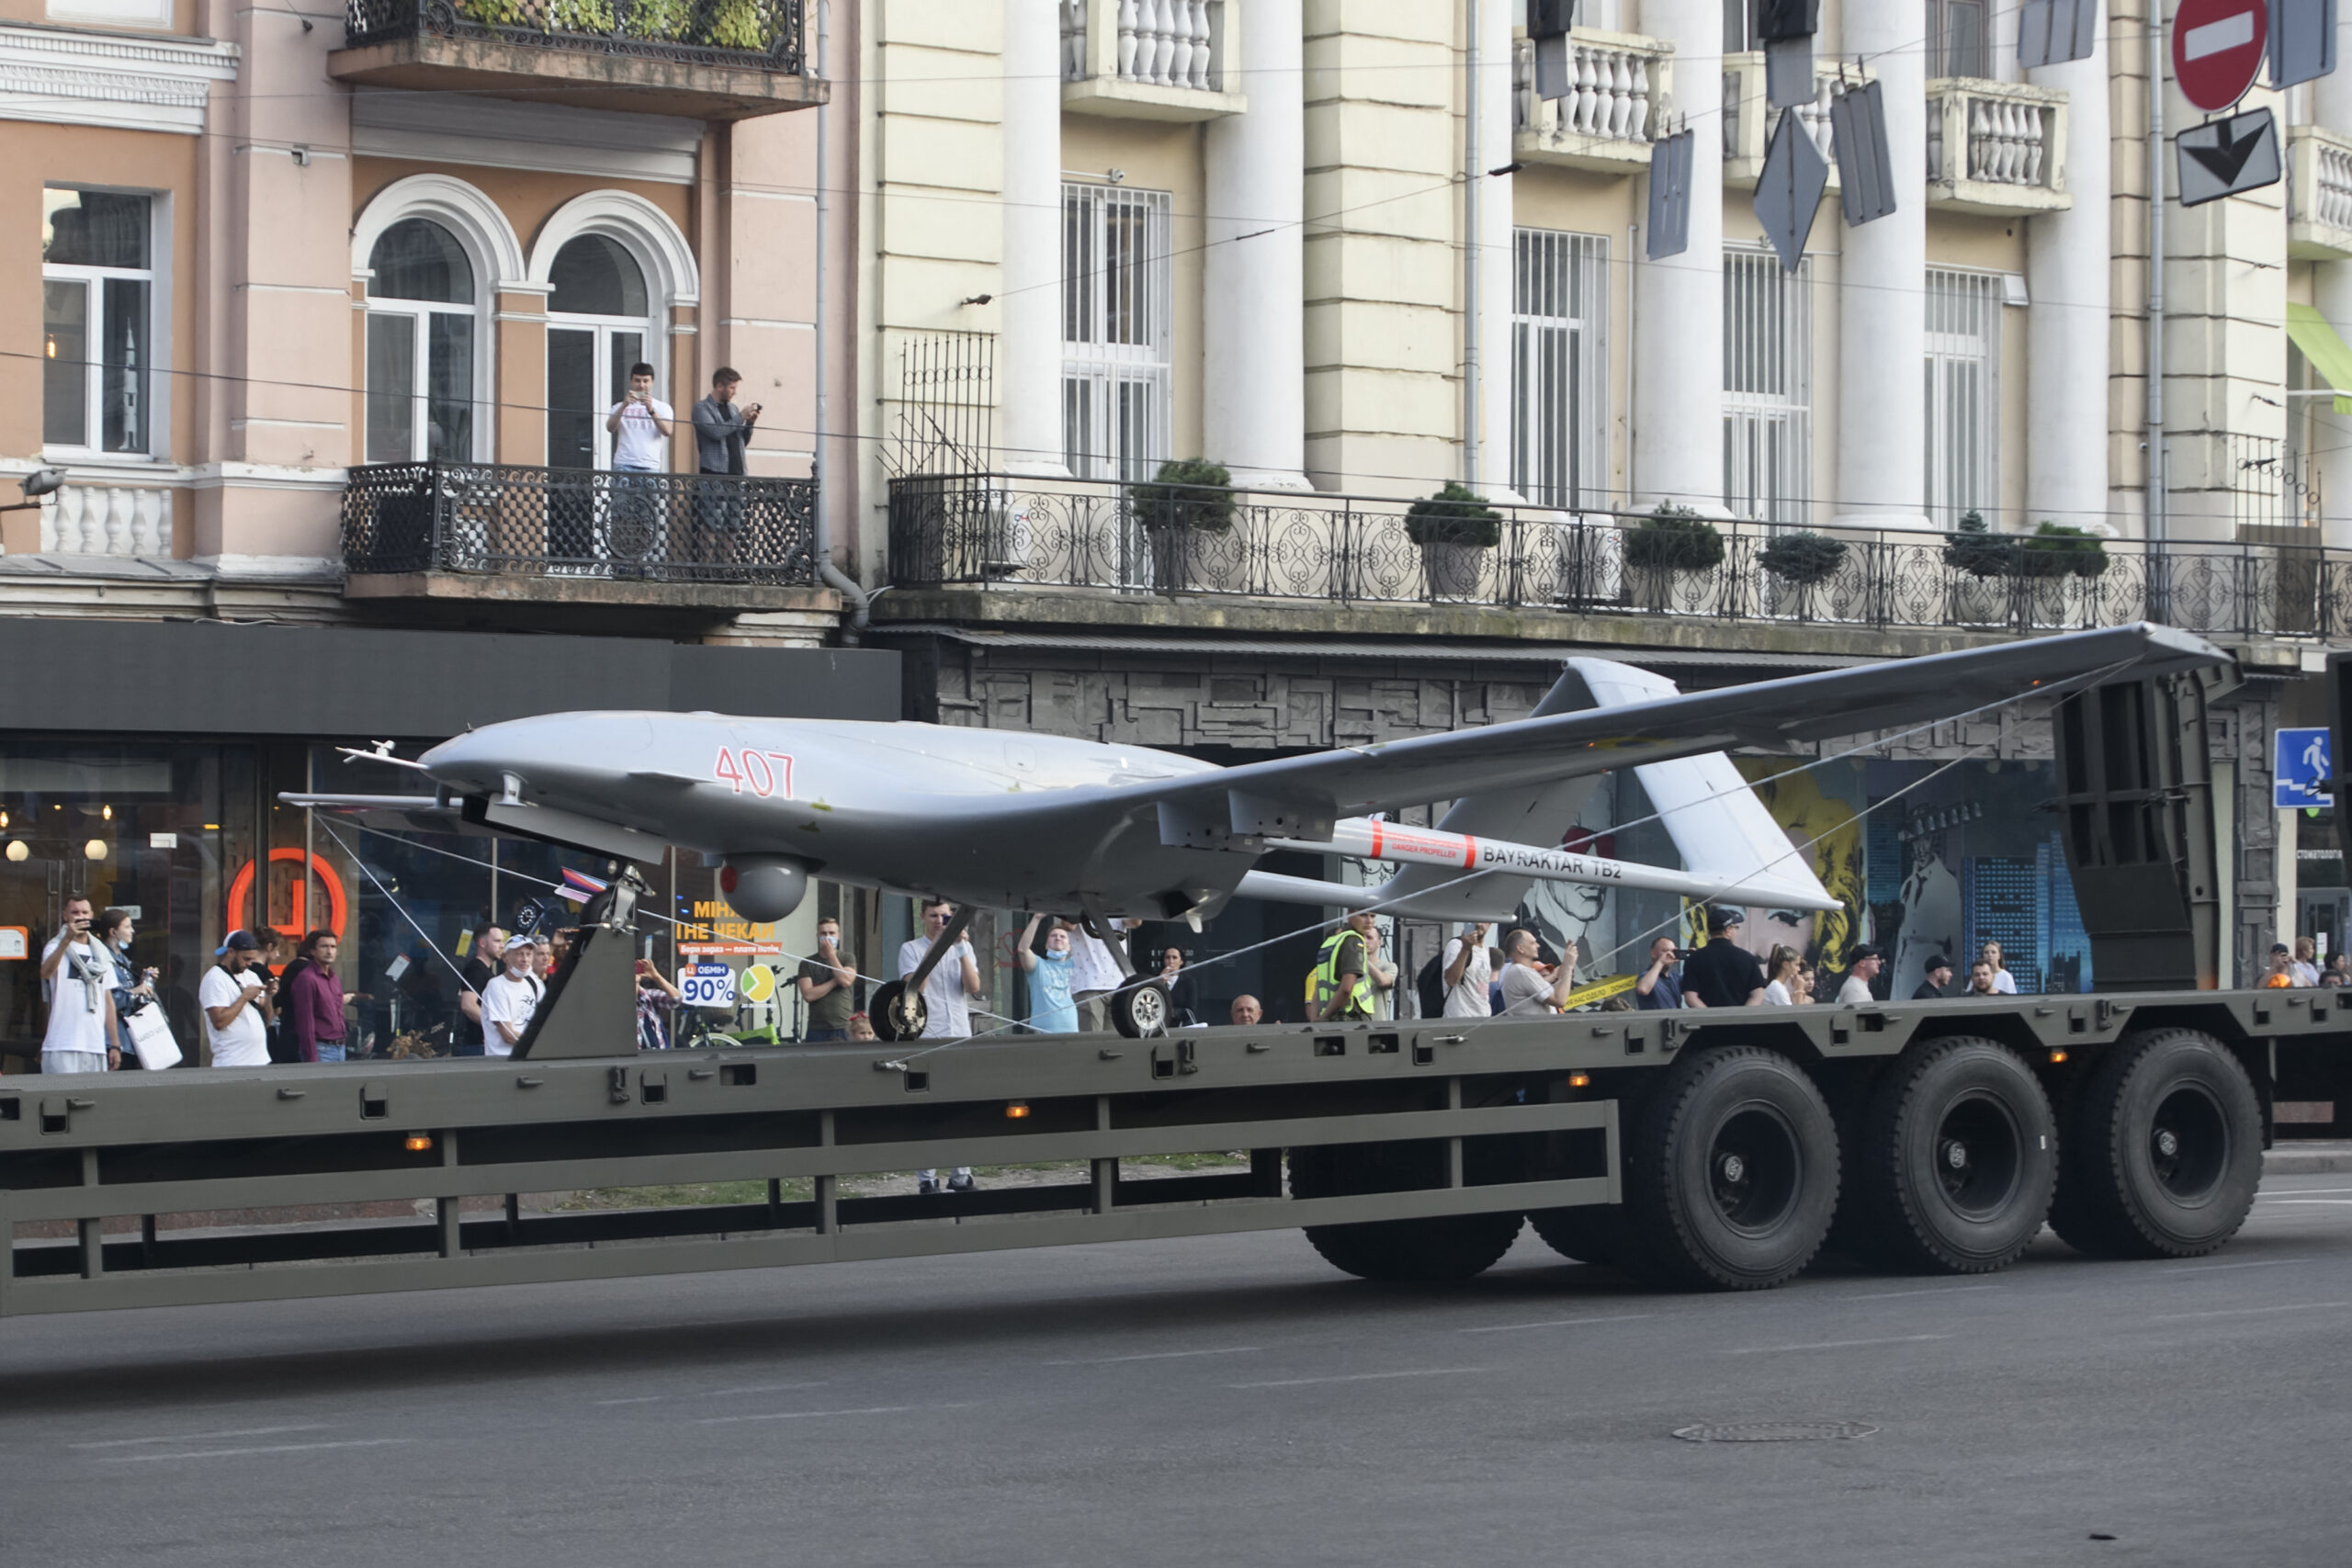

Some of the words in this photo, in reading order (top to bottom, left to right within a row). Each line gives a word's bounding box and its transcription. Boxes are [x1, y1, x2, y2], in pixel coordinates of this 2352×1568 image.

[715, 746, 793, 799] 407
[1392, 842, 1419, 853] DANGER
[1419, 846, 1457, 858] PROPELLER
[1483, 846, 1584, 874] BAYRAKTAR
[1591, 860, 1622, 879] TB2
[684, 923, 709, 940] НЕ
[697, 966, 726, 975] ОБМІН
[684, 979, 736, 1001] 90%
